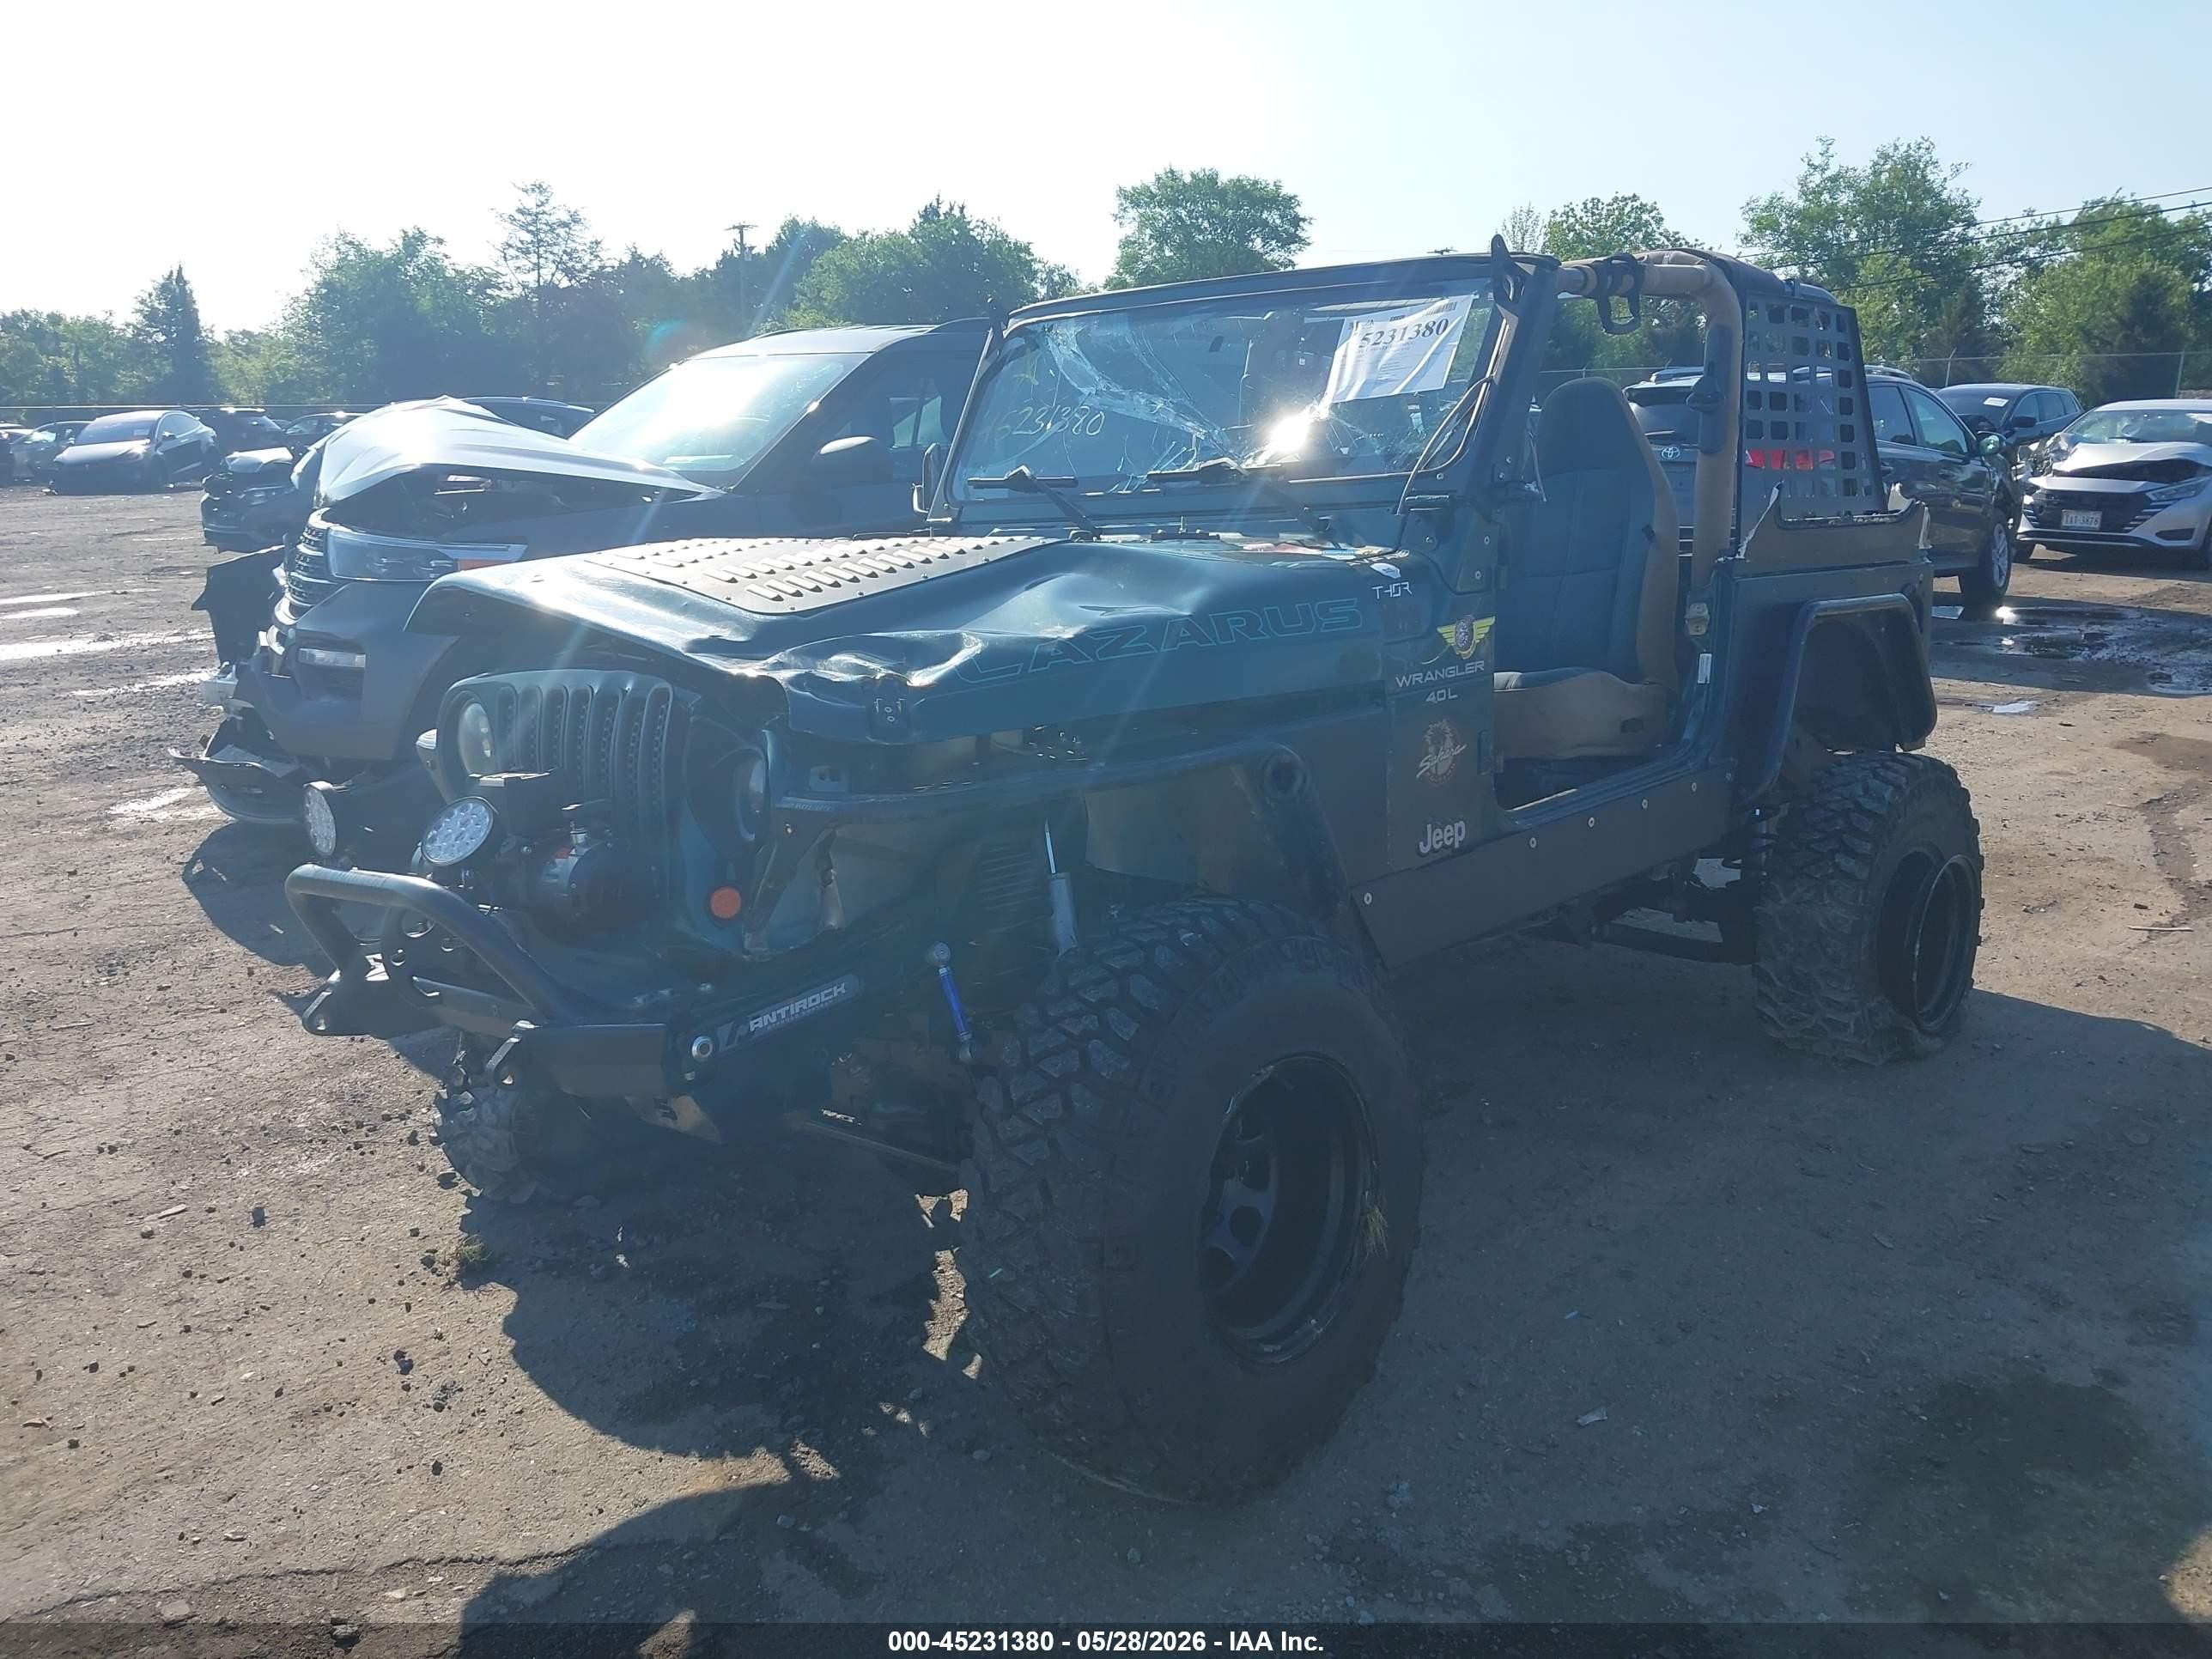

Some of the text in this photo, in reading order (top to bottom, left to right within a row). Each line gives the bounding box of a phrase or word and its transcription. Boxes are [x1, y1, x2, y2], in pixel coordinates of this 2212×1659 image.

[1371, 581, 1413, 599] THOR
[952, 598, 1364, 684] LAZARUS
[1395, 660, 1485, 688] WRANGLER
[1419, 820, 1466, 854] Jeep
[749, 982, 847, 1032] ANTIROCK
